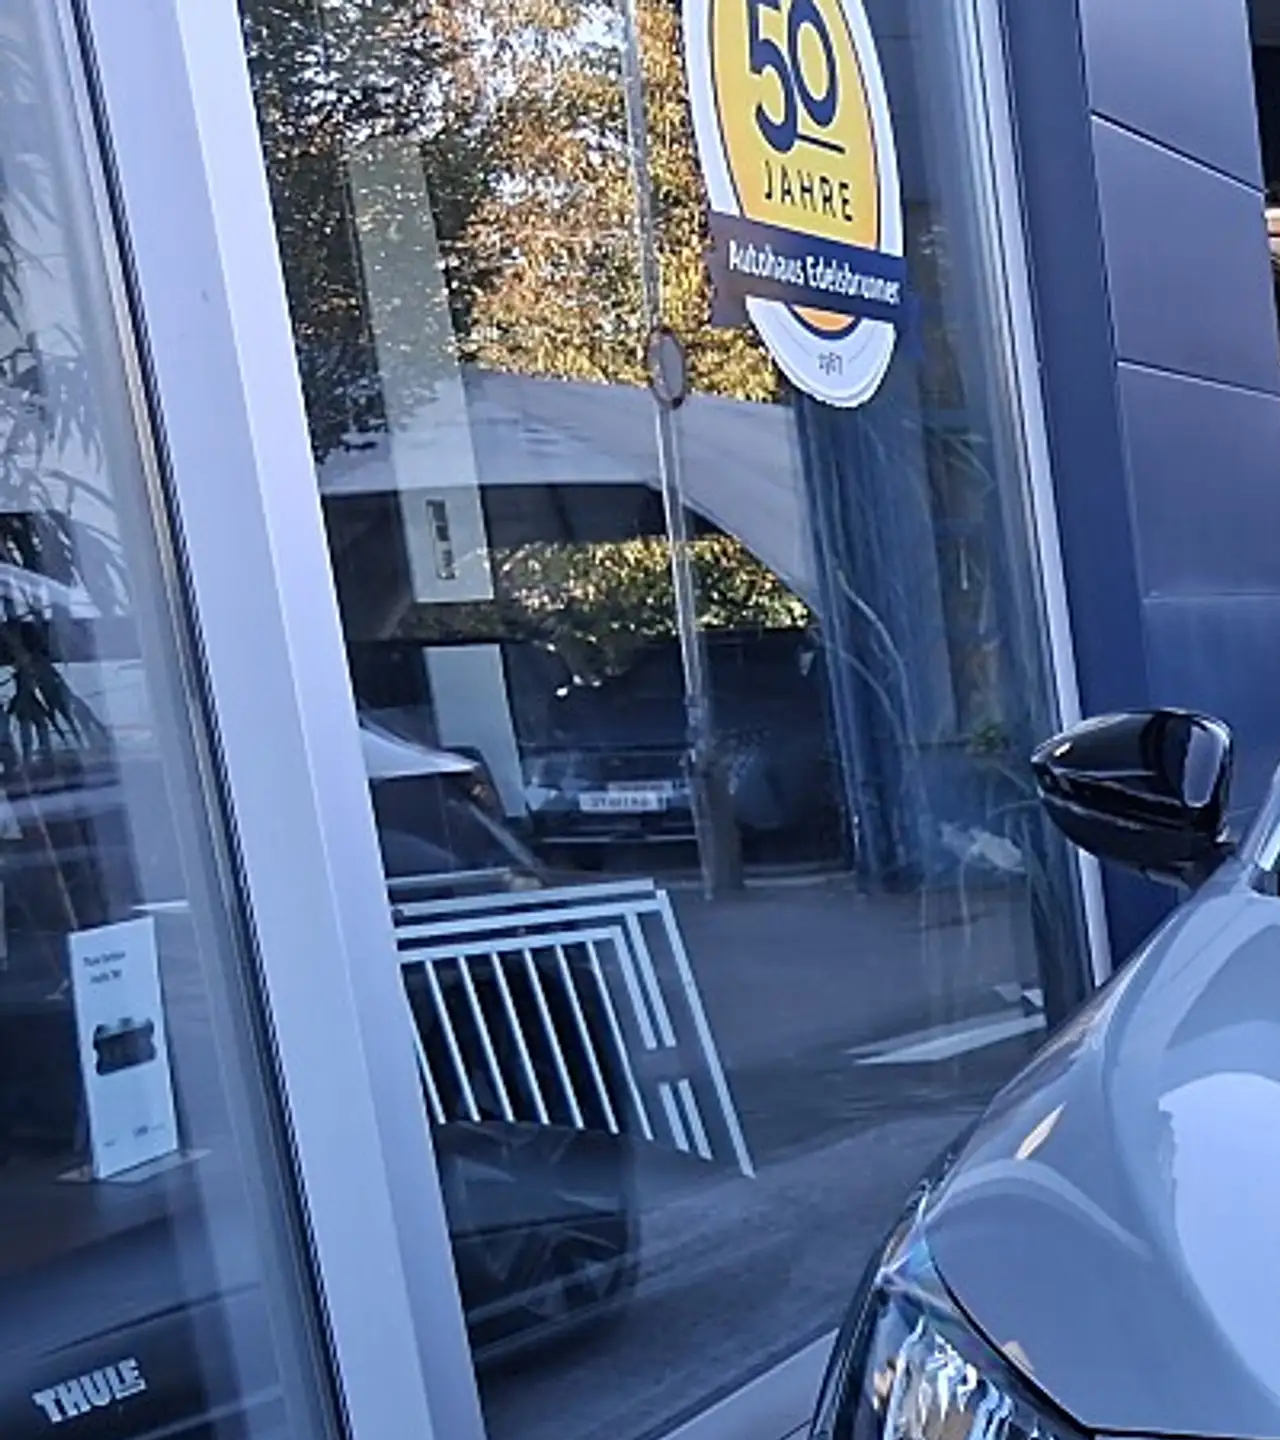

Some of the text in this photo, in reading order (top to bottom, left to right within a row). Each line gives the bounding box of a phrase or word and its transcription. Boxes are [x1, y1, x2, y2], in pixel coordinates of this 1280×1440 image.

[746, 0, 838, 153] 50
[764, 159, 854, 222] JAHRE
[728, 239, 900, 304] Autohaus Edelsbrunner
[32, 1357, 146, 1423] THULE
